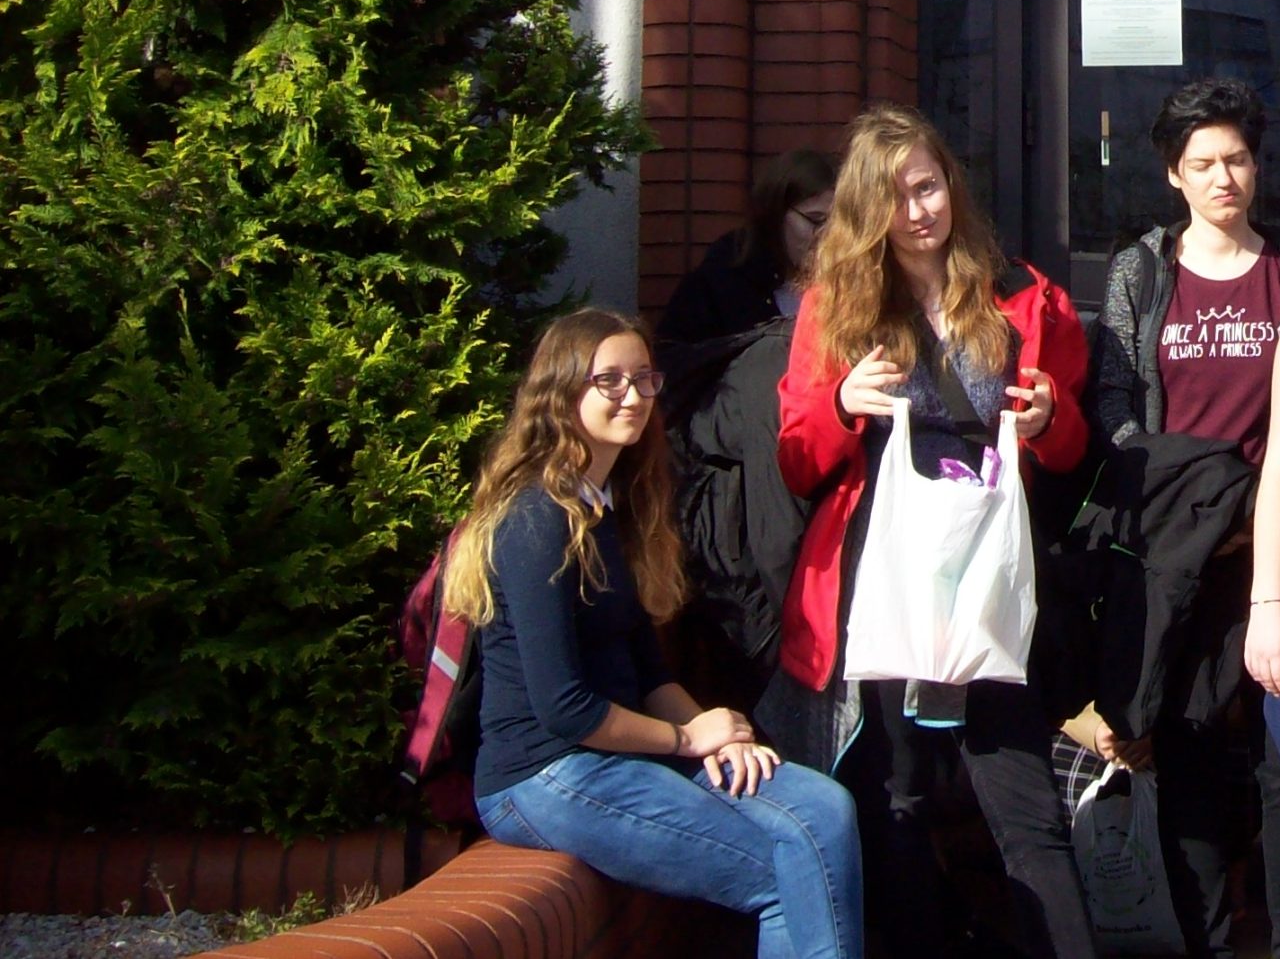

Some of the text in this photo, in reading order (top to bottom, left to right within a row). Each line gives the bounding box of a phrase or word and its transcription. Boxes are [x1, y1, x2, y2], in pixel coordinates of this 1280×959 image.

[1161, 321, 1275, 346] ONCE A PRINCESS
[1168, 341, 1262, 360] ALWAYS A PRINCESS
